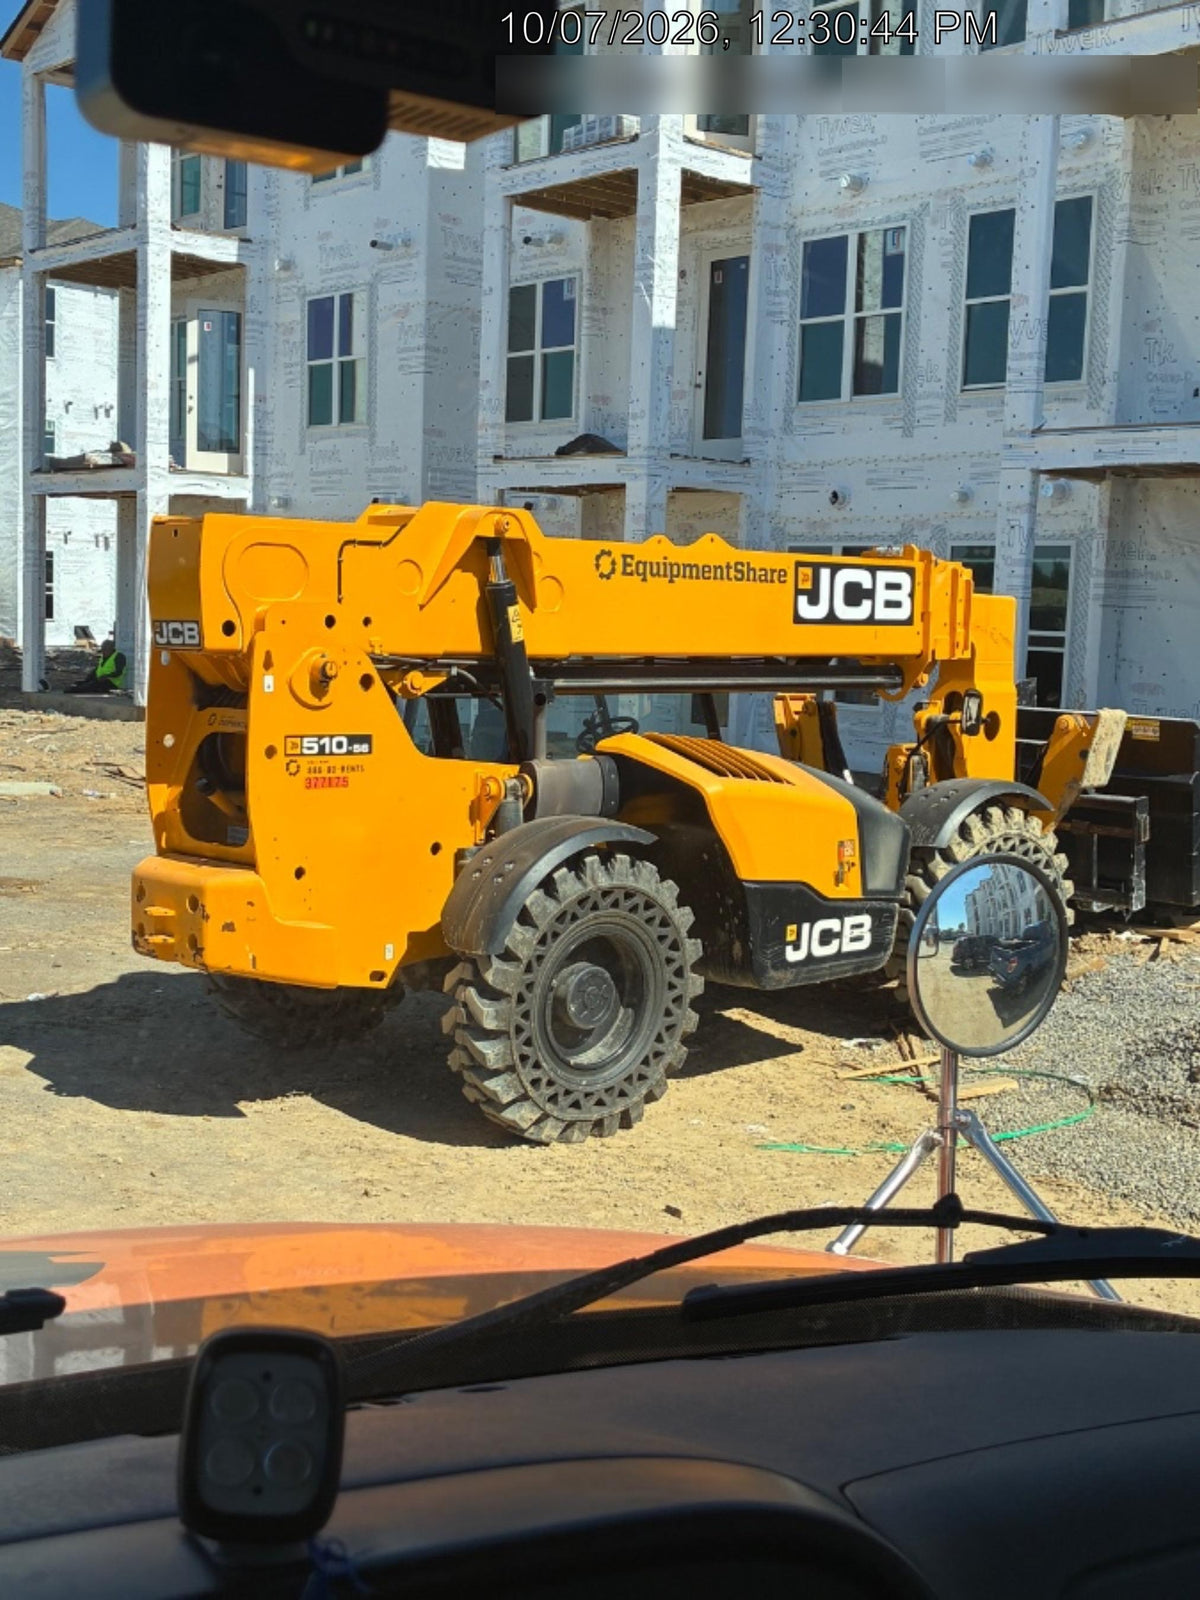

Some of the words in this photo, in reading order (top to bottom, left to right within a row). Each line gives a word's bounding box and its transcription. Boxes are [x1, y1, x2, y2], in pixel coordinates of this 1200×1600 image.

[620, 554, 788, 584] EquipmentShare
[797, 567, 913, 621] JCB
[155, 621, 200, 645] JCB
[785, 914, 872, 962] JCB
